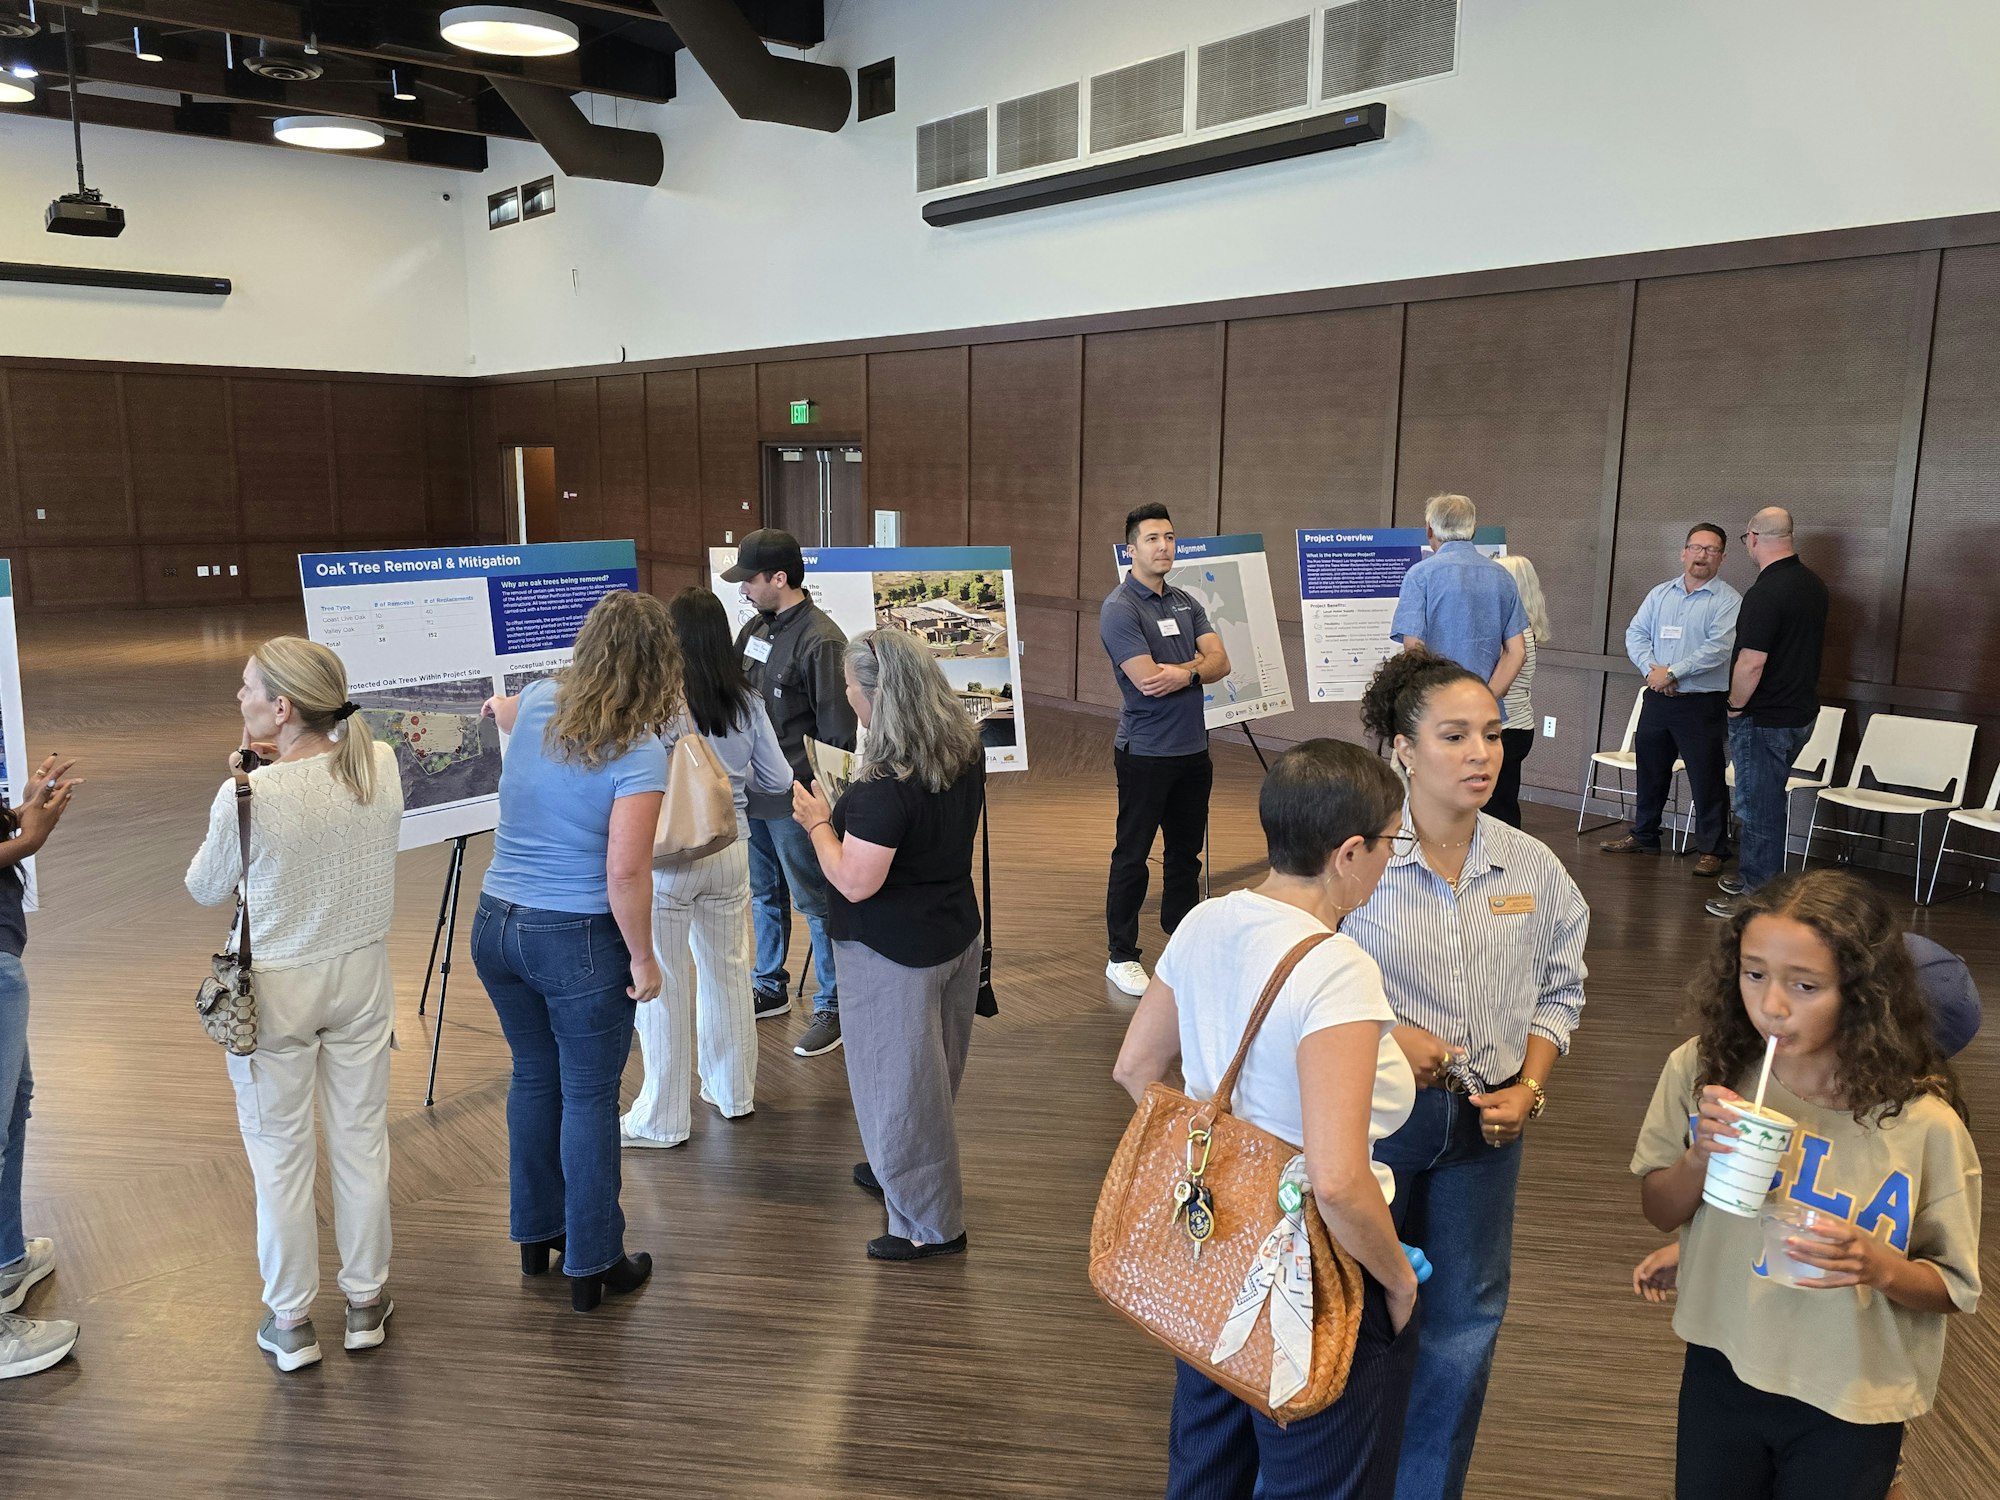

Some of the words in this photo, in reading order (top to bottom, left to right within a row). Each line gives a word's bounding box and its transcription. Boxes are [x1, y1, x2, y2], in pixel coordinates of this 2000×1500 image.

[1304, 534, 1334, 544] Project
[1335, 533, 1374, 542] Overview
[1177, 543, 1207, 554] Alignment
[316, 563, 346, 576] Oak
[349, 562, 380, 574] Tree
[384, 558, 442, 573] Removal
[446, 557, 455, 569] &
[458, 554, 521, 569] Mitigation
[501, 581, 517, 589] Why
[580, 574, 609, 583] removed?
[509, 661, 544, 670] Conceptual
[399, 676, 417, 684] Trees
[419, 673, 441, 681] Within
[443, 670, 466, 679] Project
